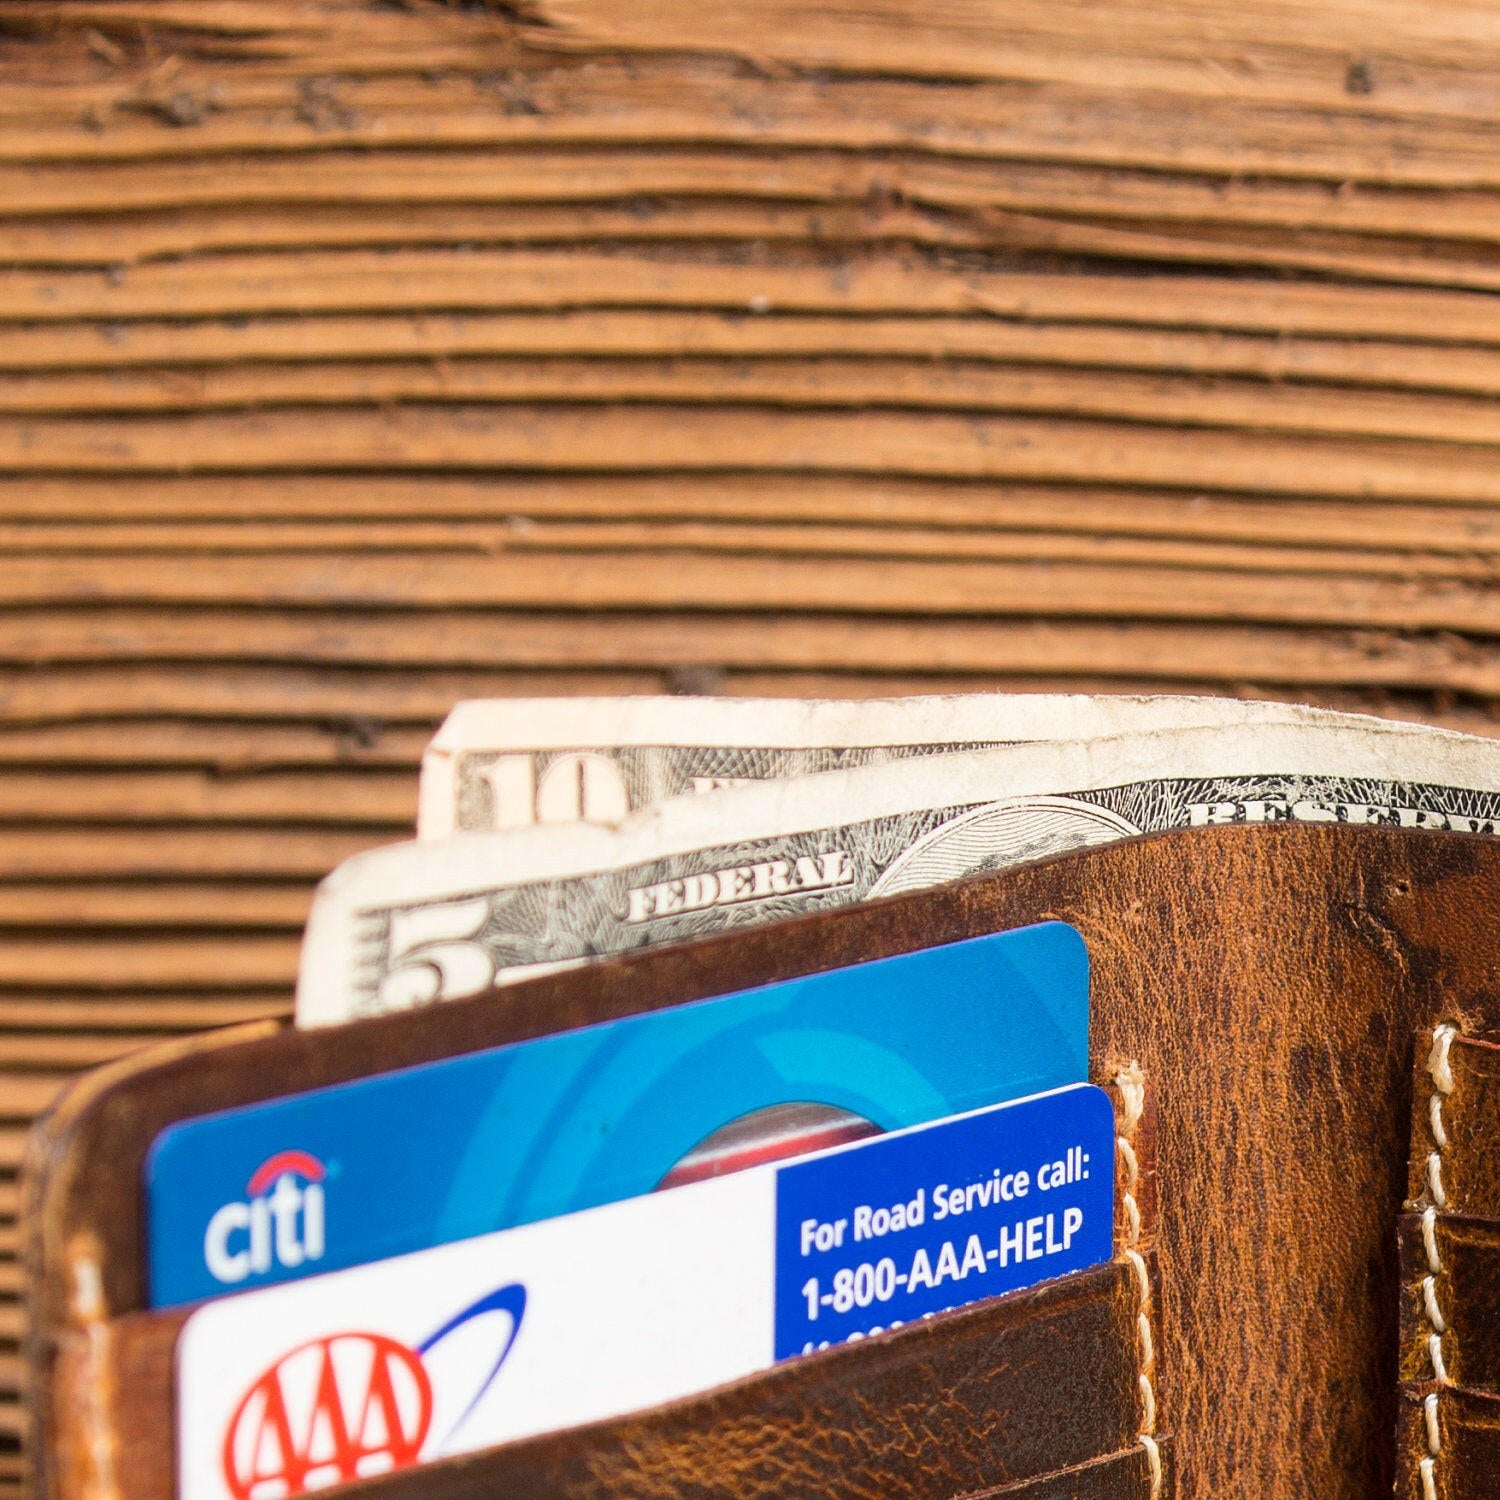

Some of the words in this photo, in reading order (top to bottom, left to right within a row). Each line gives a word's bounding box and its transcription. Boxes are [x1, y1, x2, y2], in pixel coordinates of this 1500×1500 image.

[474, 752, 632, 824] 10
[625, 850, 855, 922] FEDERAL
[380, 897, 497, 1010] 5
[203, 1173, 326, 1284] citi
[800, 1218, 848, 1257] For
[853, 1187, 925, 1242] Road
[932, 1167, 1030, 1220] Service
[1037, 1145, 1090, 1191] call:
[801, 1207, 1084, 1321] 1-800-AAA-HELP
